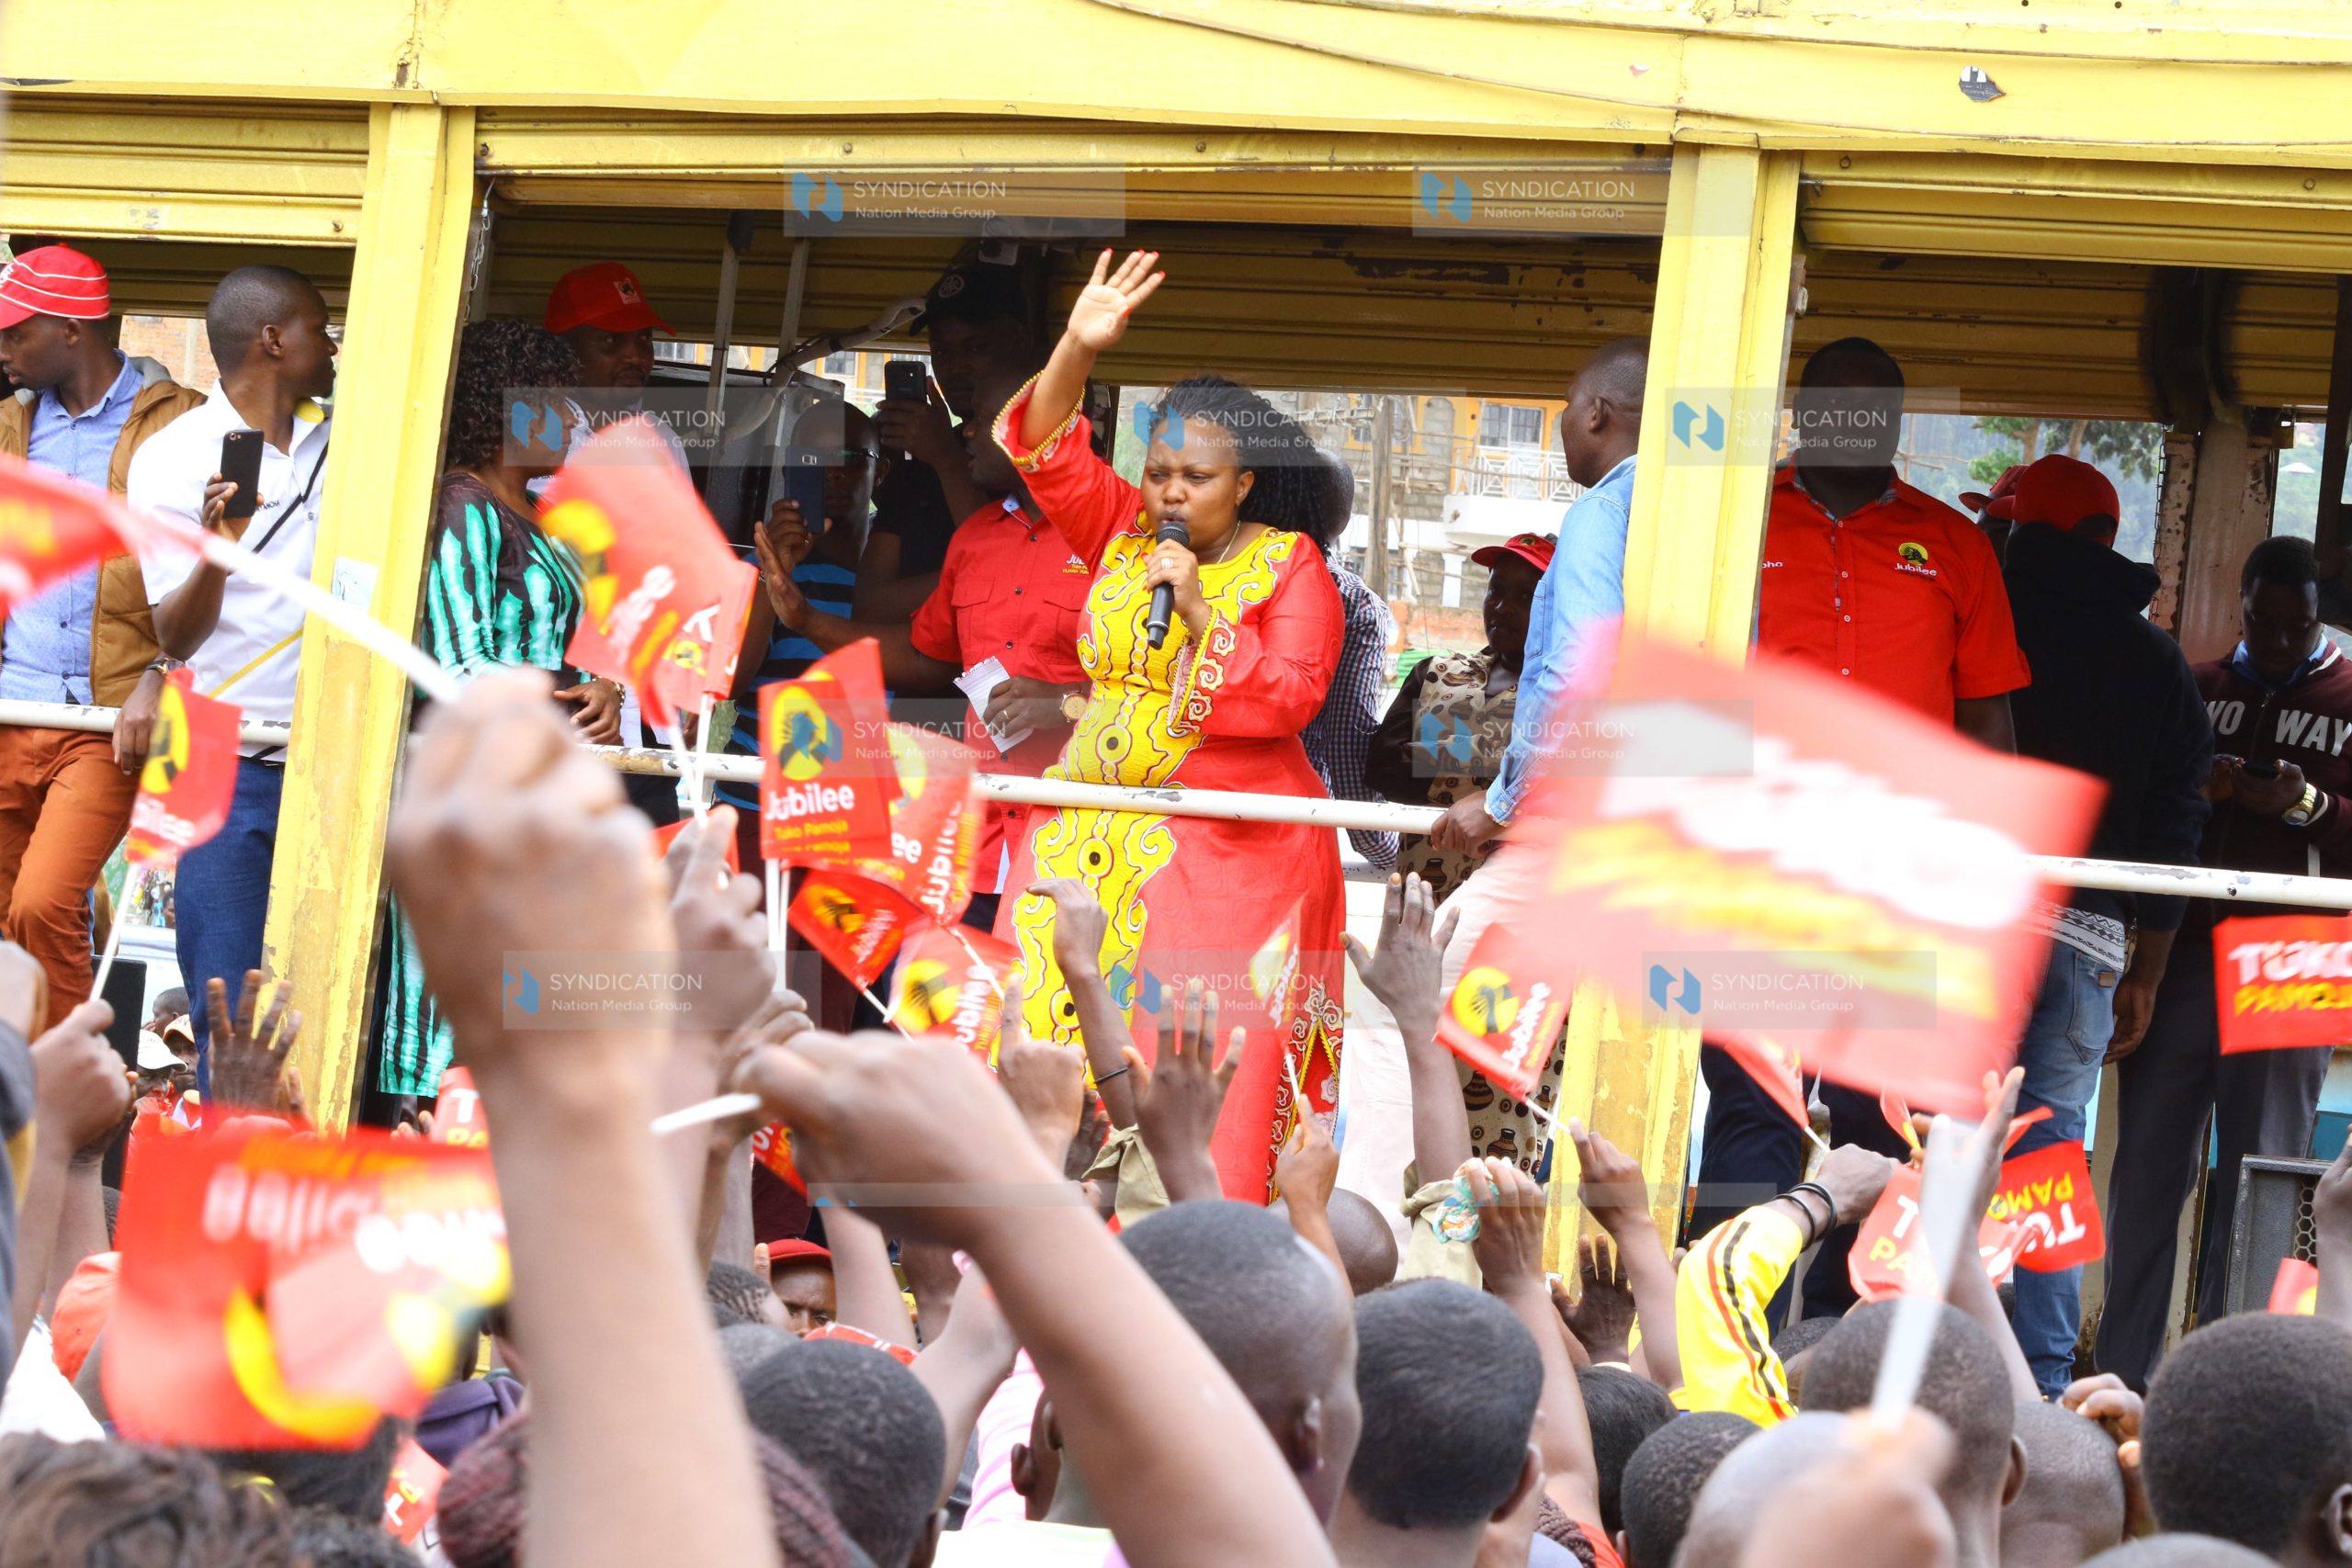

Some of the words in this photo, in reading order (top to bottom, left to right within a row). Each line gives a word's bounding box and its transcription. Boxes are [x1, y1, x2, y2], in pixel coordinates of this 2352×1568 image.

[1894, 562, 1938, 577] Jubilee
[2275, 709, 2352, 757] WAY
[764, 783, 855, 820] Jubilee
